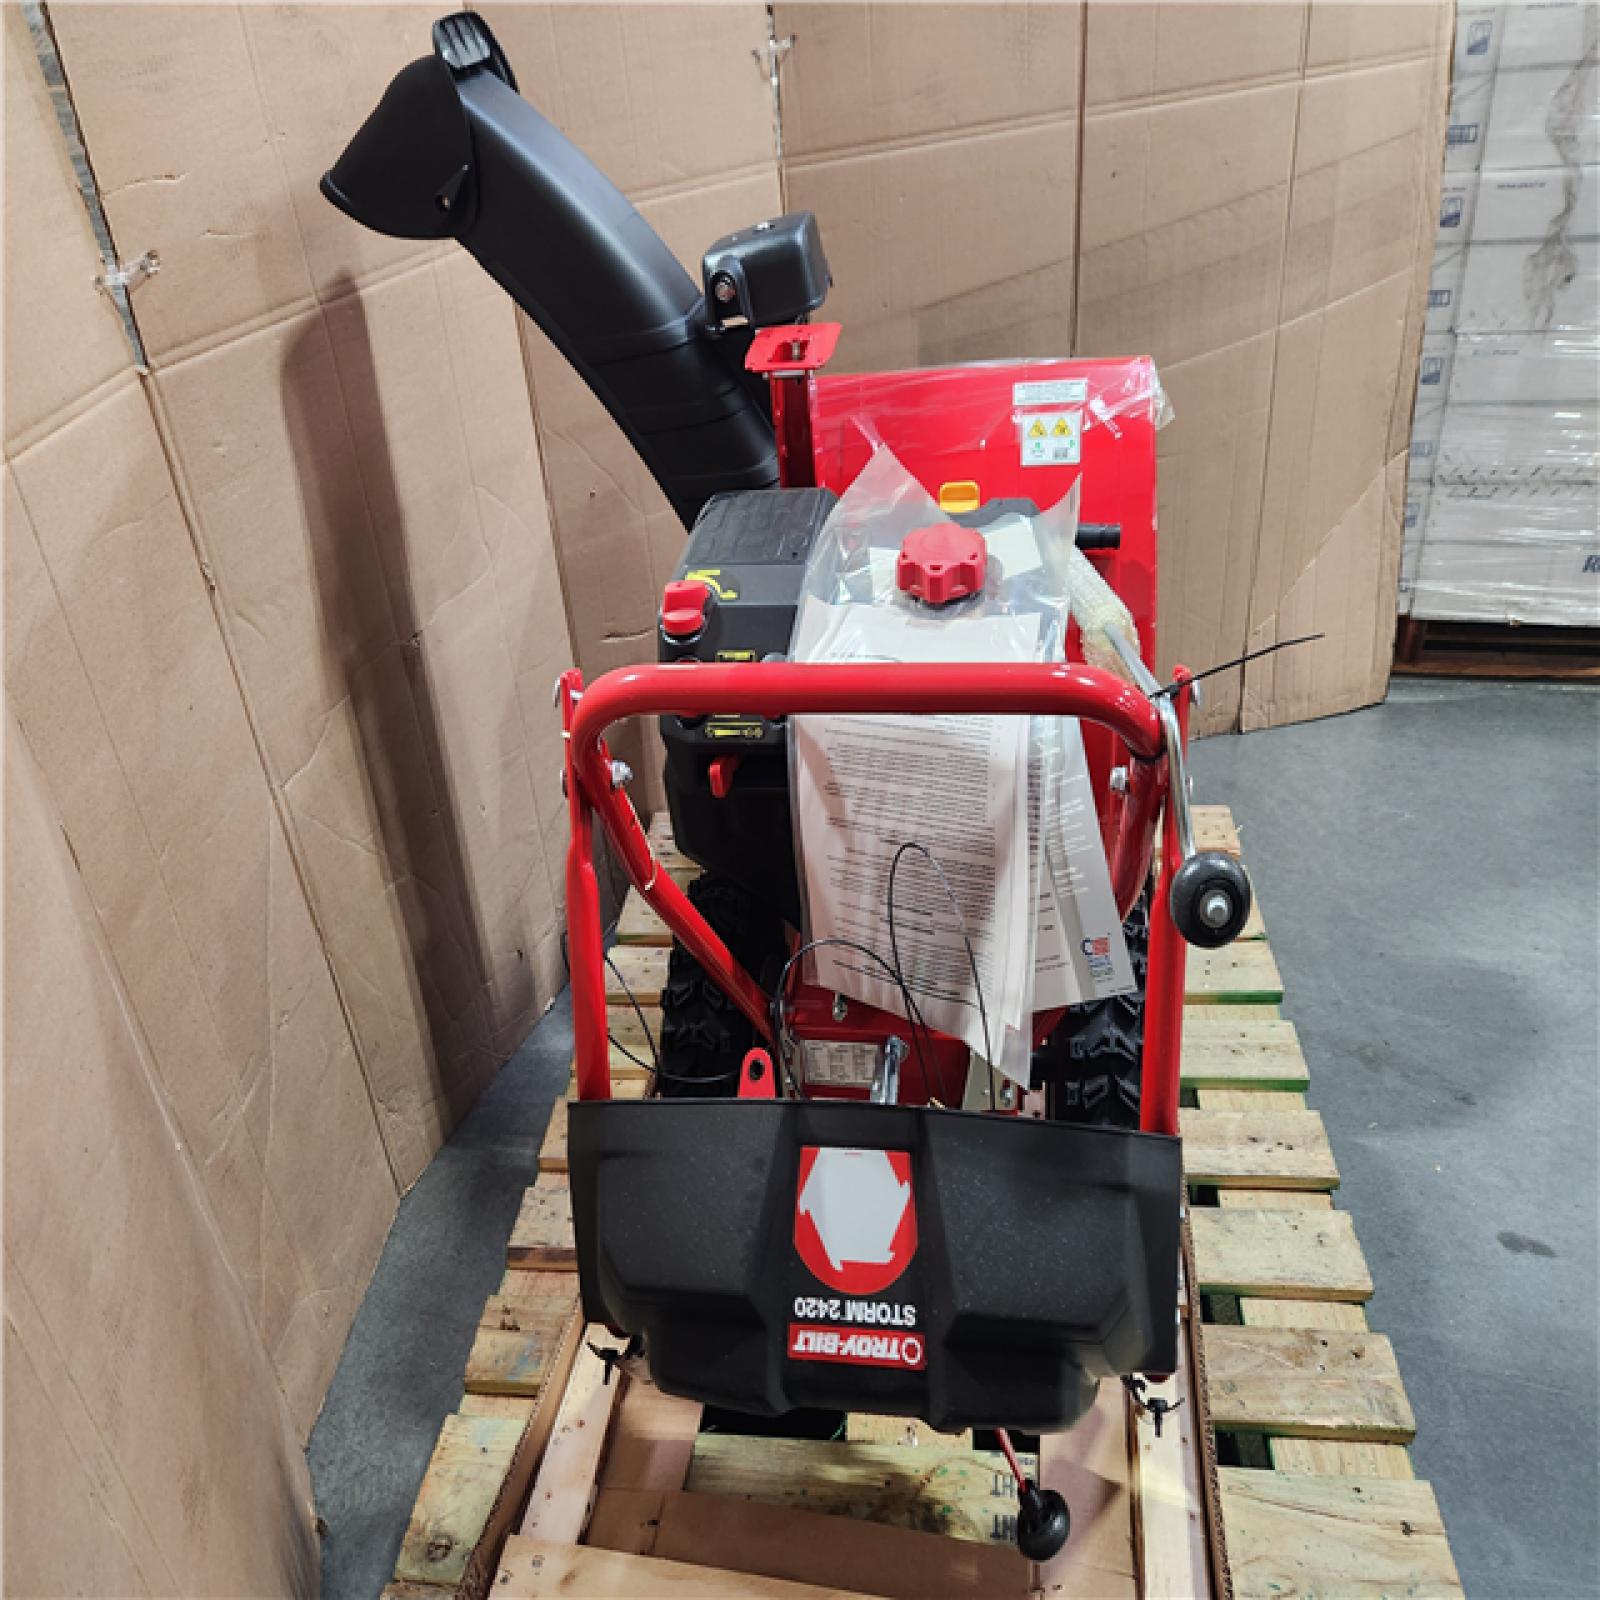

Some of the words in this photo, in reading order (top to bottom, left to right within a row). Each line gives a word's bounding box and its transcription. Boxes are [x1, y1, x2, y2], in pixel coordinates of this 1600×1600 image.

[794, 1297, 841, 1320] 2420
[845, 1299, 916, 1327] STORM
[792, 1329, 901, 1361] TROY-BILT
